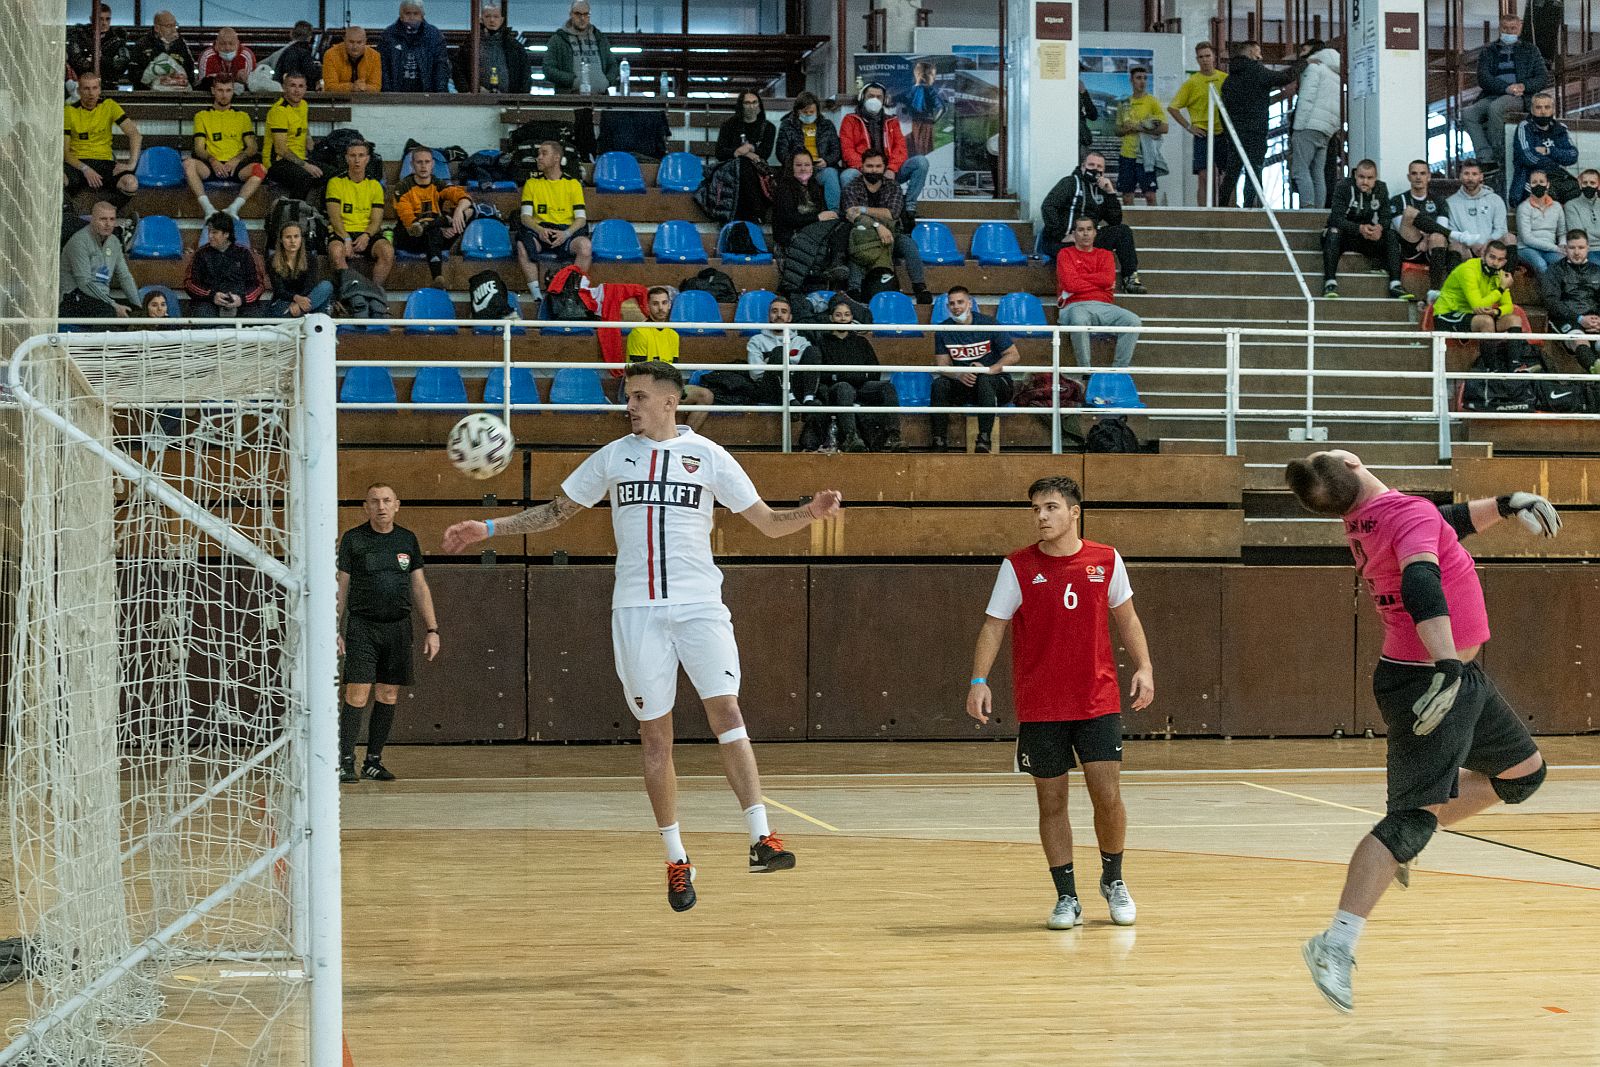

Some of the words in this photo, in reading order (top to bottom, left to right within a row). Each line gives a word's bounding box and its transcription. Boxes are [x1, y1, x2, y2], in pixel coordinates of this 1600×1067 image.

[473, 280, 496, 304] NIKE
[950, 345, 987, 358] PARIS
[618, 483, 661, 503] RELIA
[664, 484, 699, 506] KFT.
[1063, 583, 1078, 610] 6
